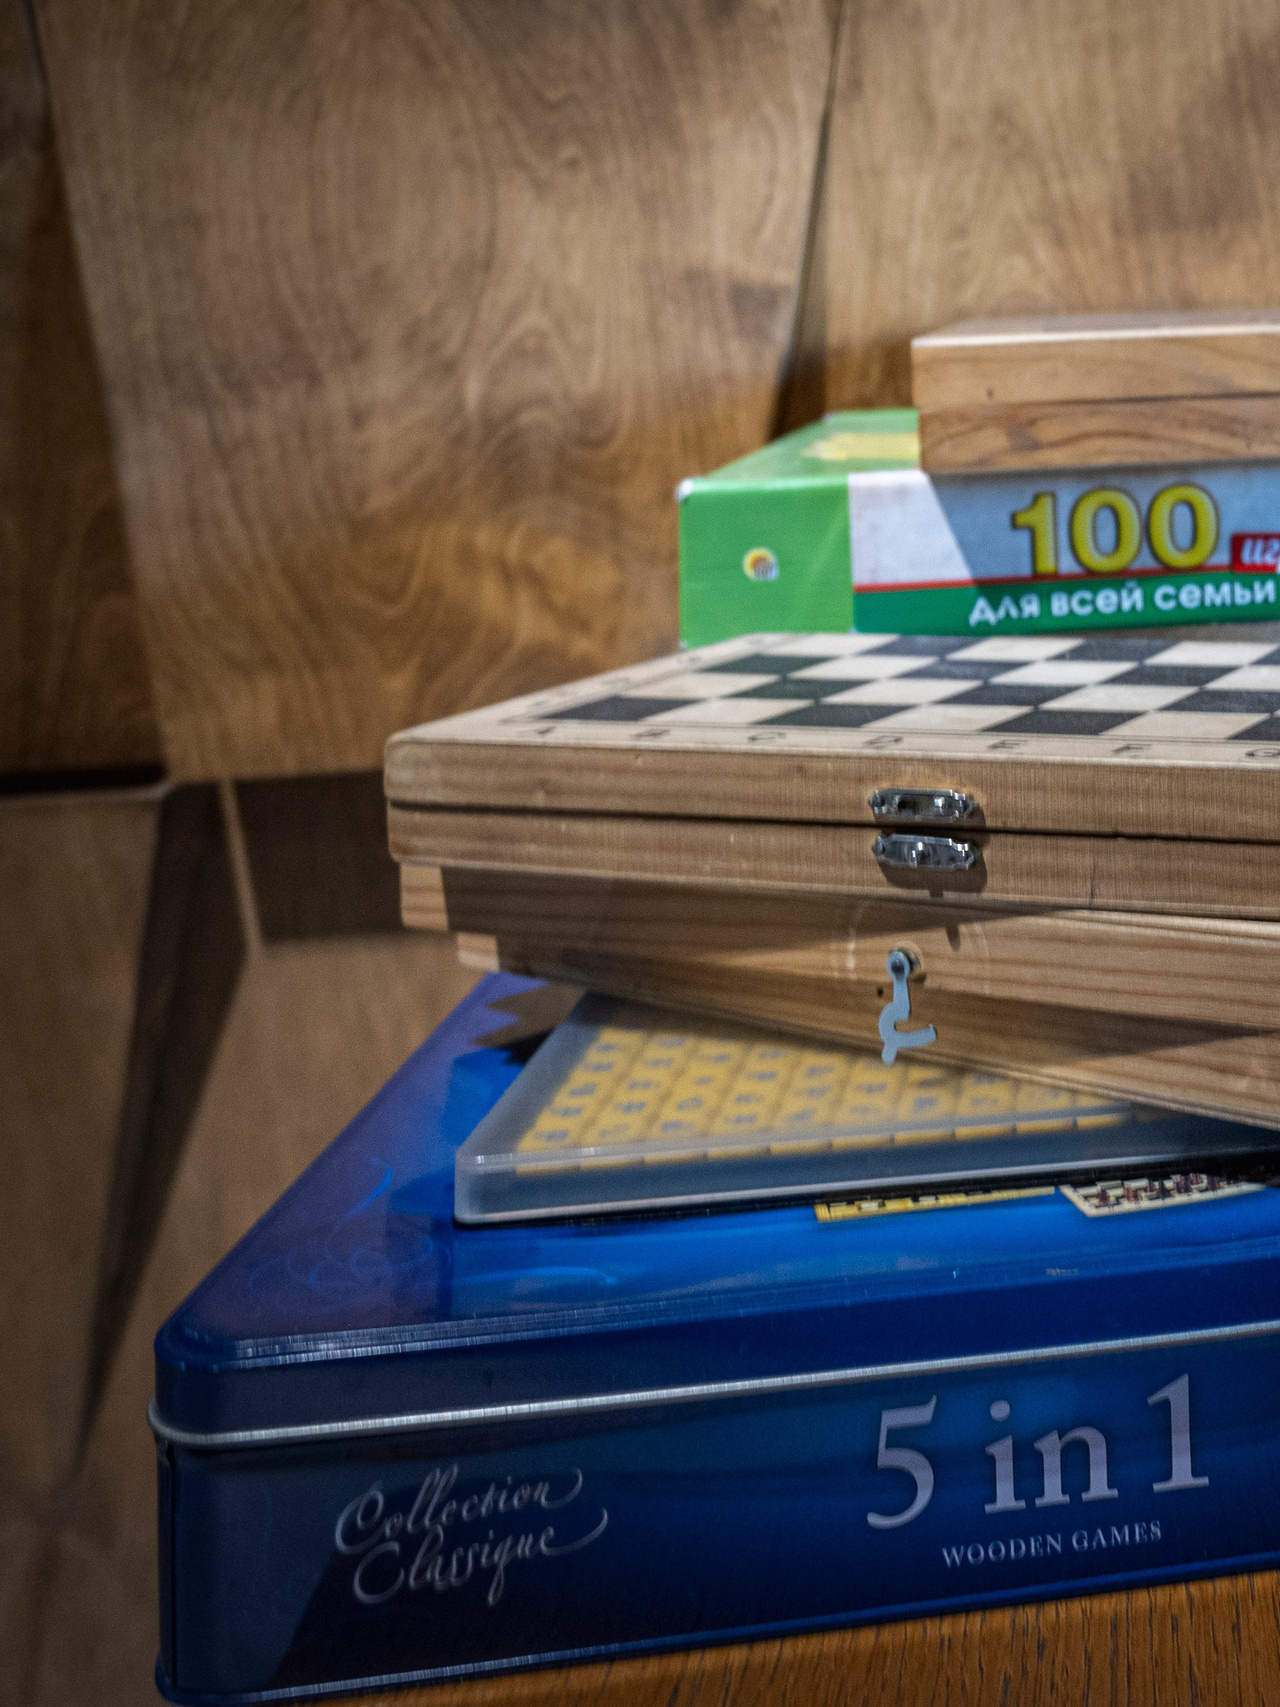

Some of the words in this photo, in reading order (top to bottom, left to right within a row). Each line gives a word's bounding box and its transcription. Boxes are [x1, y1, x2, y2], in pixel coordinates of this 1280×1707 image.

[1010, 483, 1221, 578] 100
[1049, 579, 1145, 618] всей
[1153, 577, 1279, 611] семьи
[866, 1394, 937, 1530] 5
[984, 1400, 1119, 1514] in
[1147, 1372, 1210, 1494] 1
[334, 1462, 584, 1555] Collection
[941, 1532, 1062, 1569] WOODEN
[1071, 1520, 1162, 1552] GAMES
[353, 1507, 609, 1607] Classique
